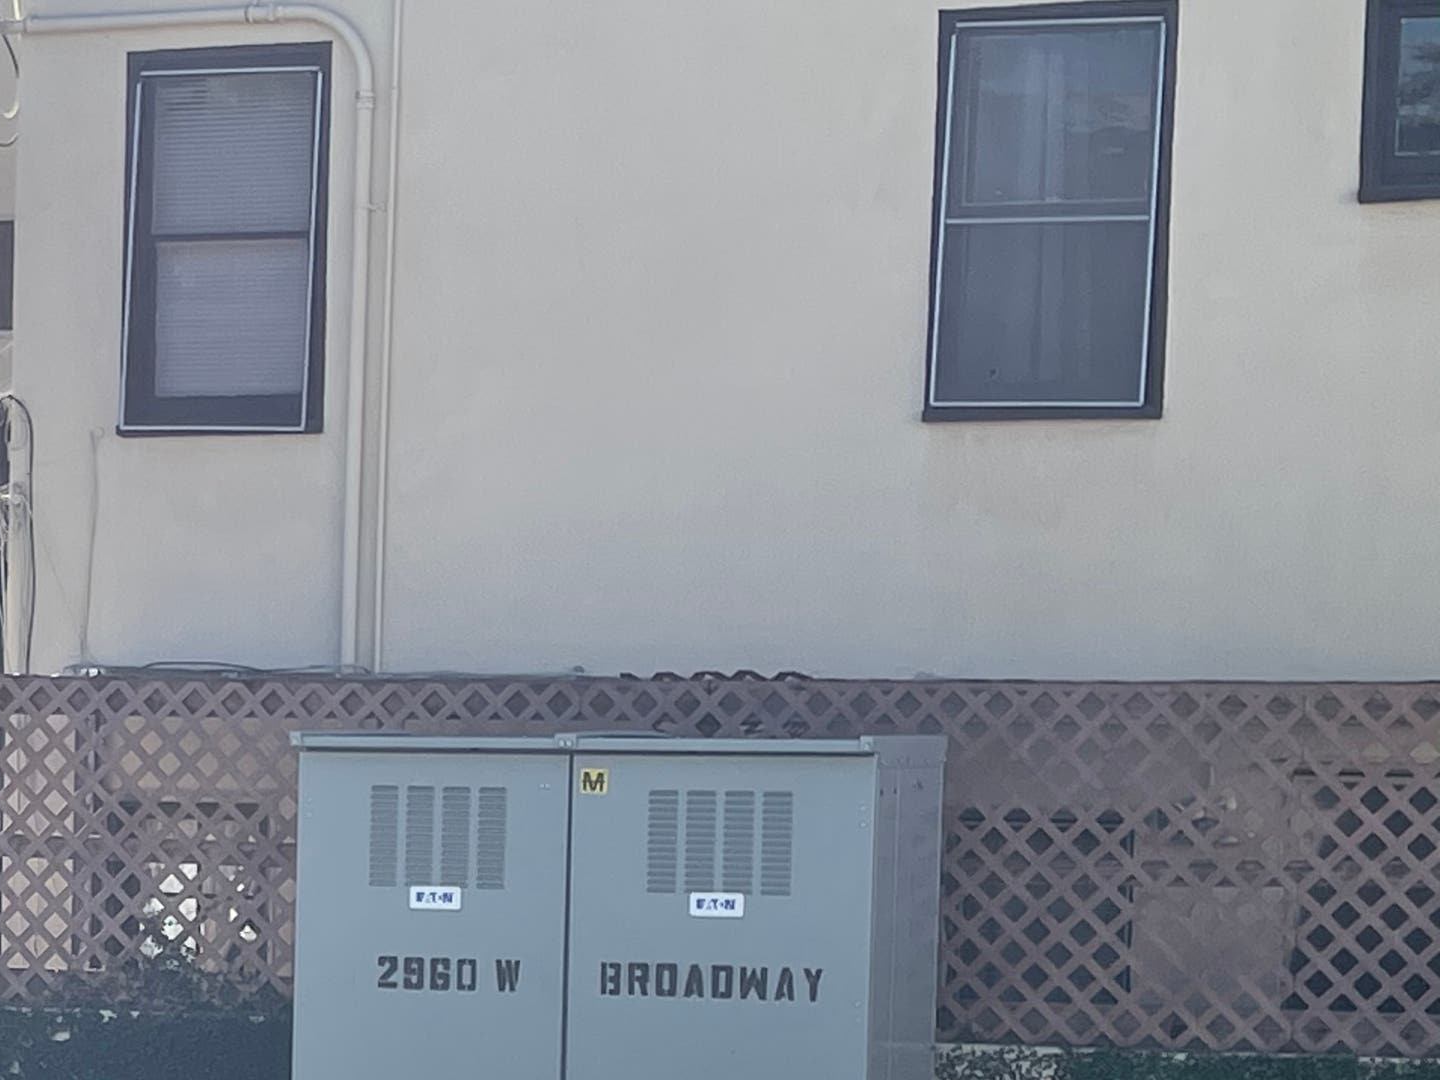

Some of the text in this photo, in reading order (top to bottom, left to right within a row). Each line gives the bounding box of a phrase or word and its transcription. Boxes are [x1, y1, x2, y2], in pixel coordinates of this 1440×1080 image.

[582, 771, 606, 792] M
[377, 956, 823, 1002] 2960 W BROADWAY
